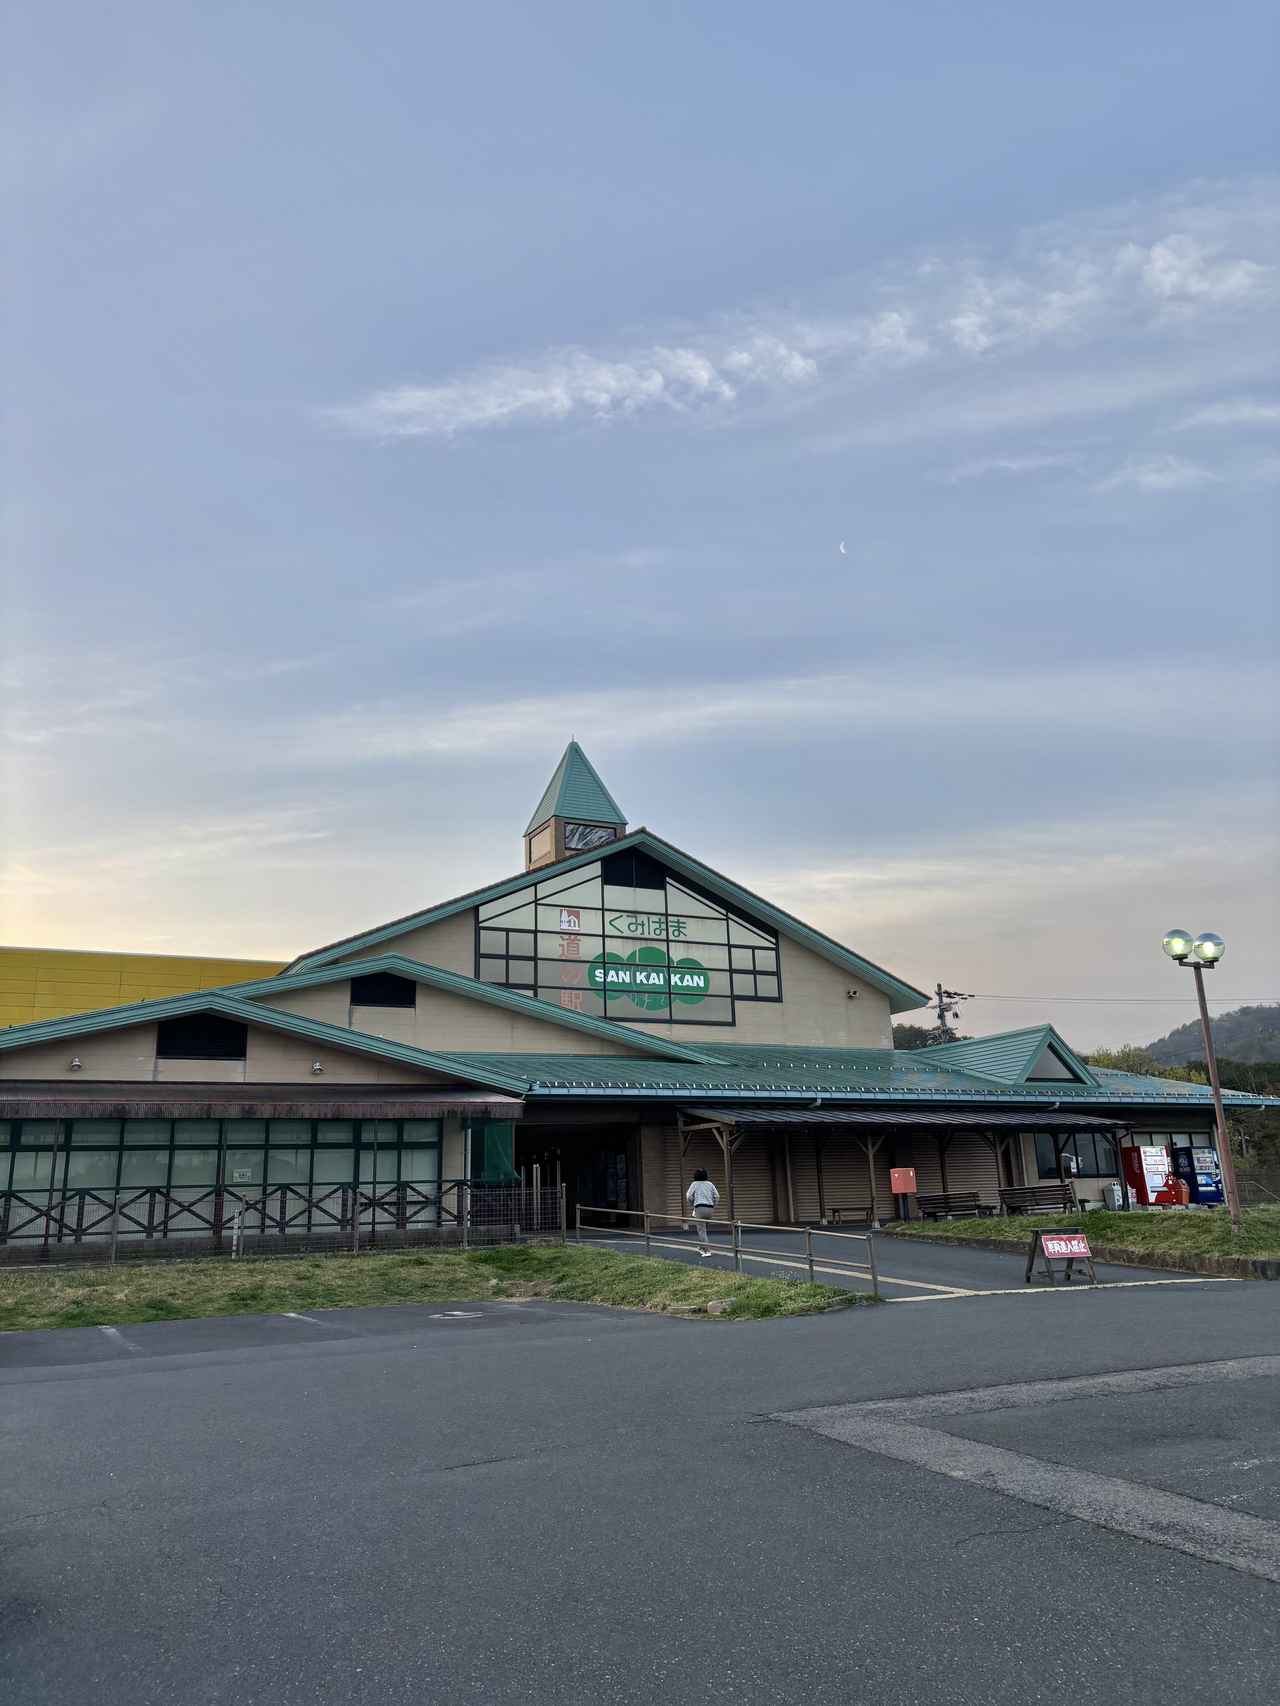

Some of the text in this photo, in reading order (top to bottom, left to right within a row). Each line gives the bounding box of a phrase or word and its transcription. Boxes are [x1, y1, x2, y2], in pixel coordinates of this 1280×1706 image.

[609, 915, 687, 938] くみはま
[594, 969, 705, 987] SAN KAI KAN
